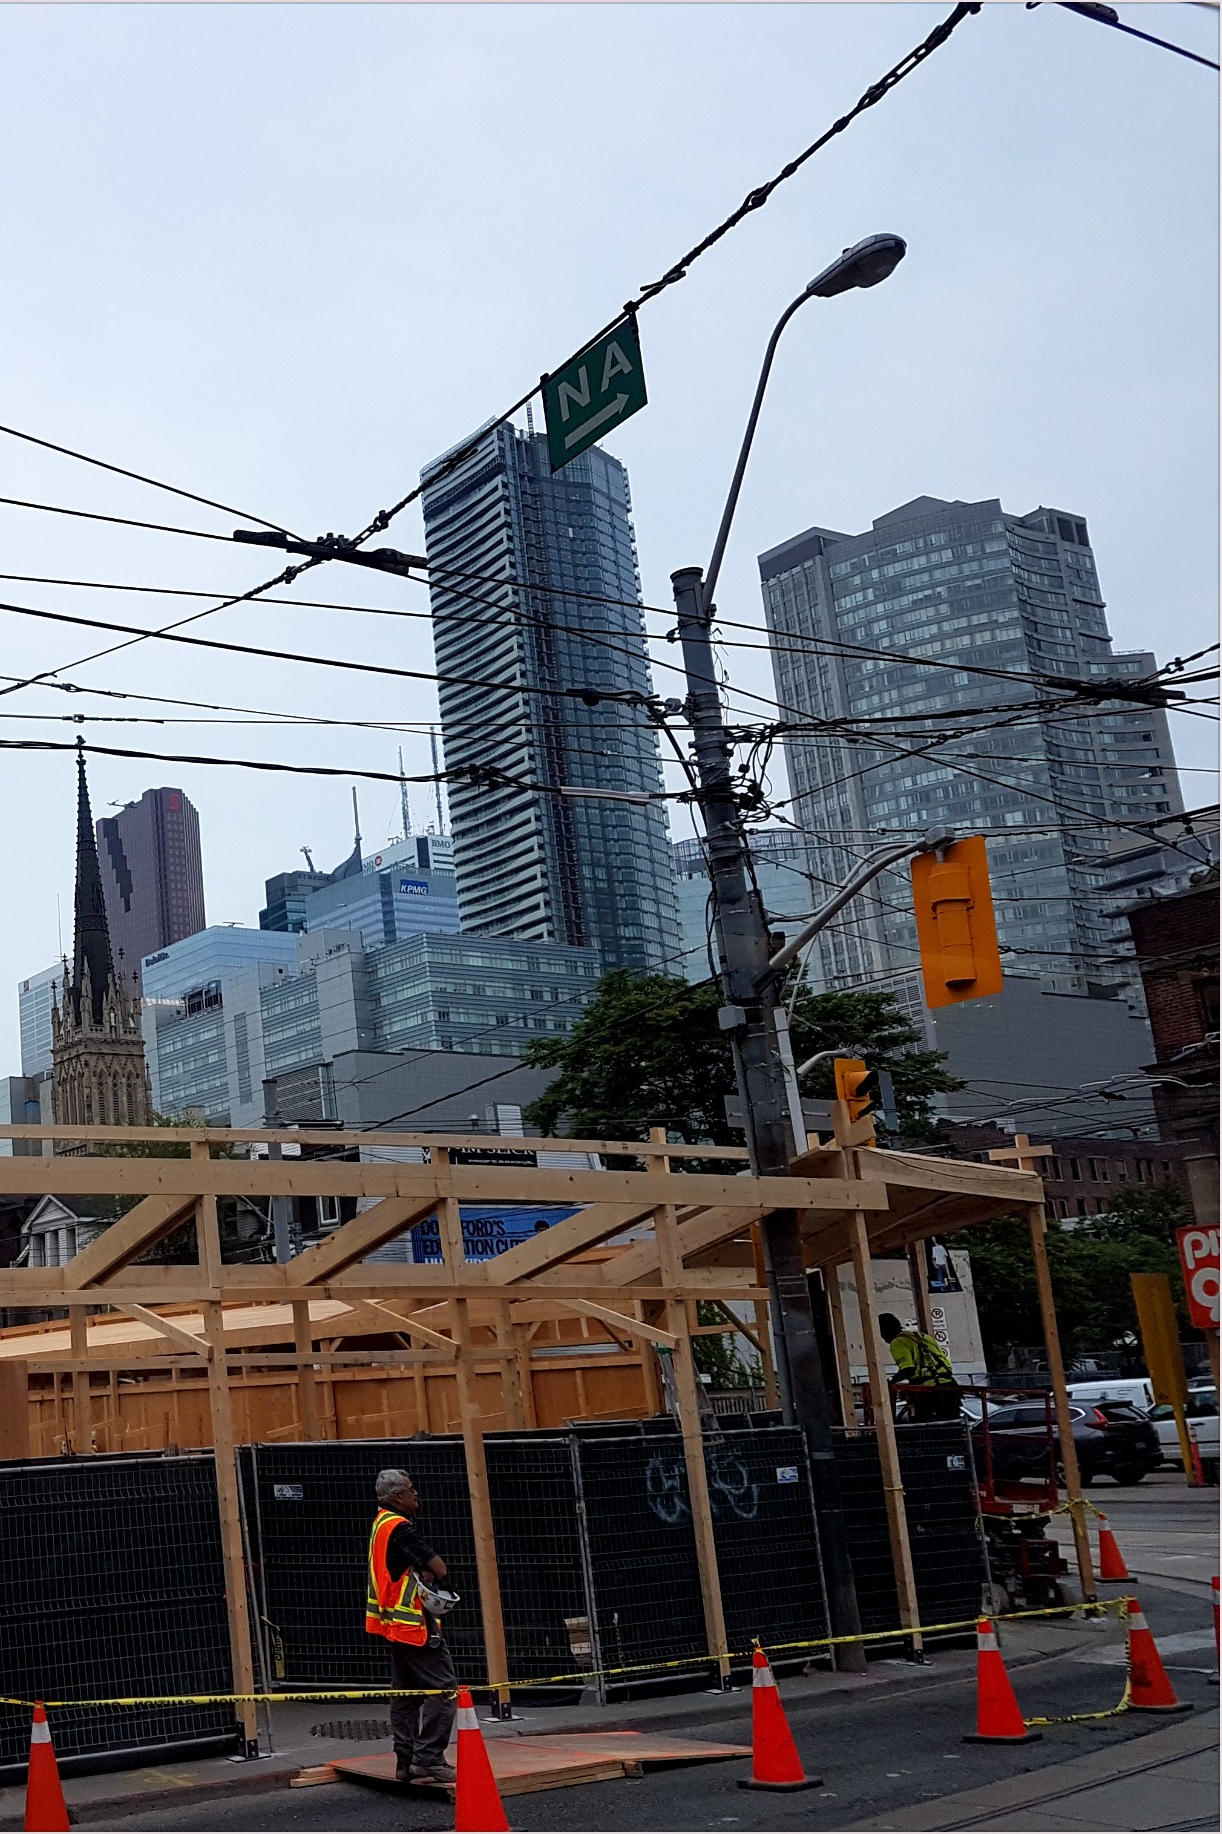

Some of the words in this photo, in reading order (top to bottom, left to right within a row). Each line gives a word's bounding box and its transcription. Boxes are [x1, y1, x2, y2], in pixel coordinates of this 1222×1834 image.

[431, 839, 451, 849] BMO
[400, 884, 428, 895] KPMG
[461, 1220, 506, 1237] FORD'S
